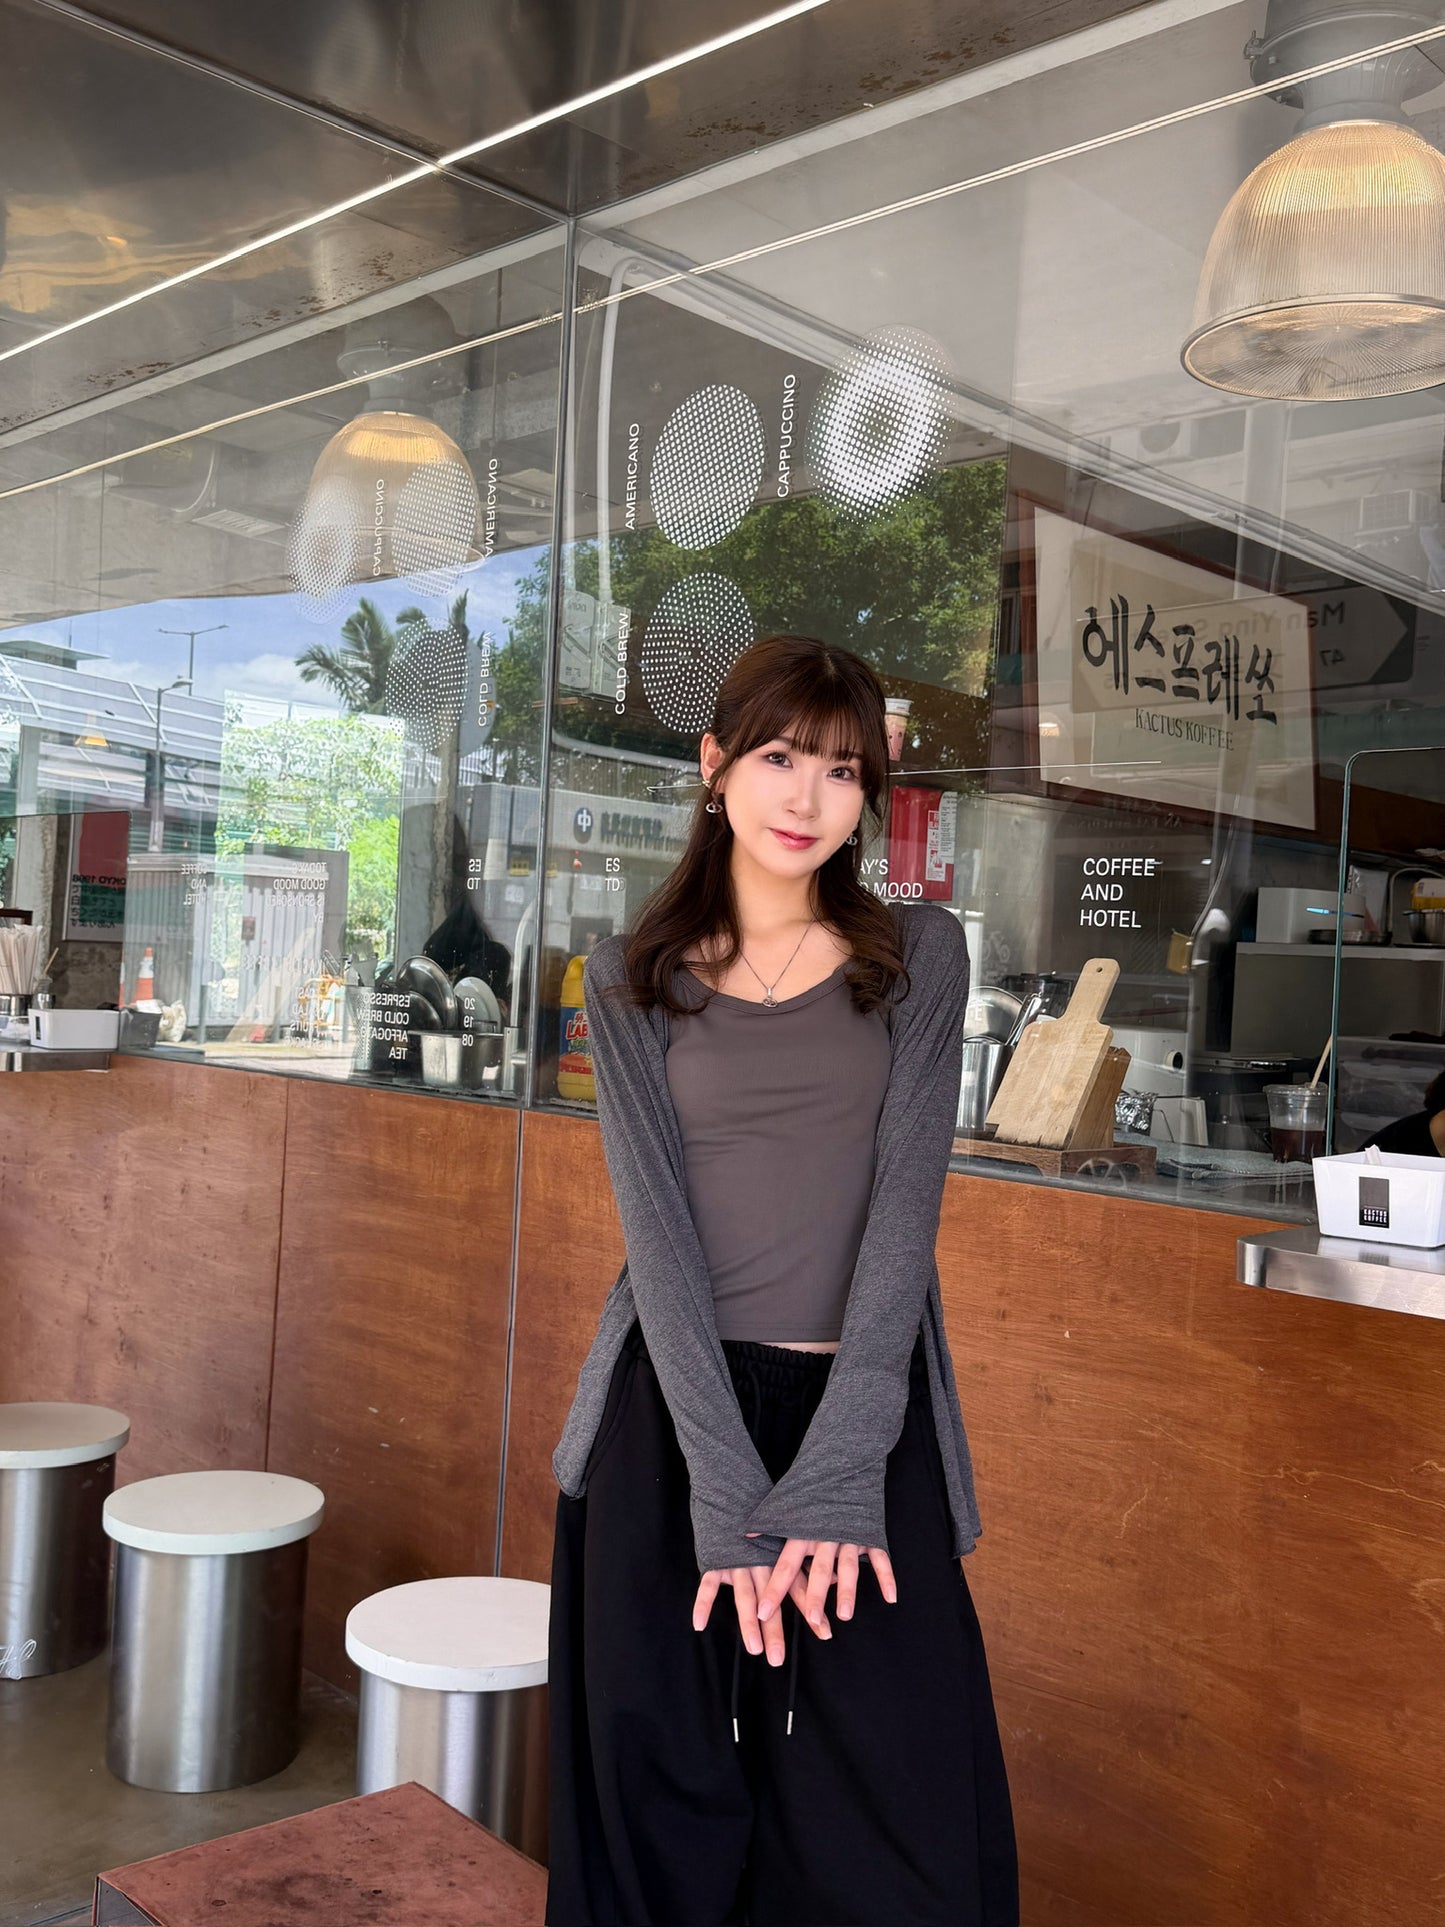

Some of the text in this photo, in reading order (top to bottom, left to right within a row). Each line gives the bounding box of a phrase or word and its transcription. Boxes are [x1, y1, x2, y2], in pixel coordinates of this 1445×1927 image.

[777, 374, 796, 498] CAPPUCCINO
[624, 422, 640, 530] AMERICANO
[614, 612, 630, 715] COLD BREW
[1083, 593, 1277, 725] 에스프레쏘
[1135, 707, 1235, 751] KACTUS KOFFEE
[605, 858, 621, 872] ES
[860, 858, 888, 875] AY'S
[1083, 858, 1155, 876] COFFEE
[605, 878, 620, 892] TD
[873, 882, 923, 898] MOOD
[1080, 883, 1123, 901] AND
[1080, 909, 1141, 928] HOTEL
